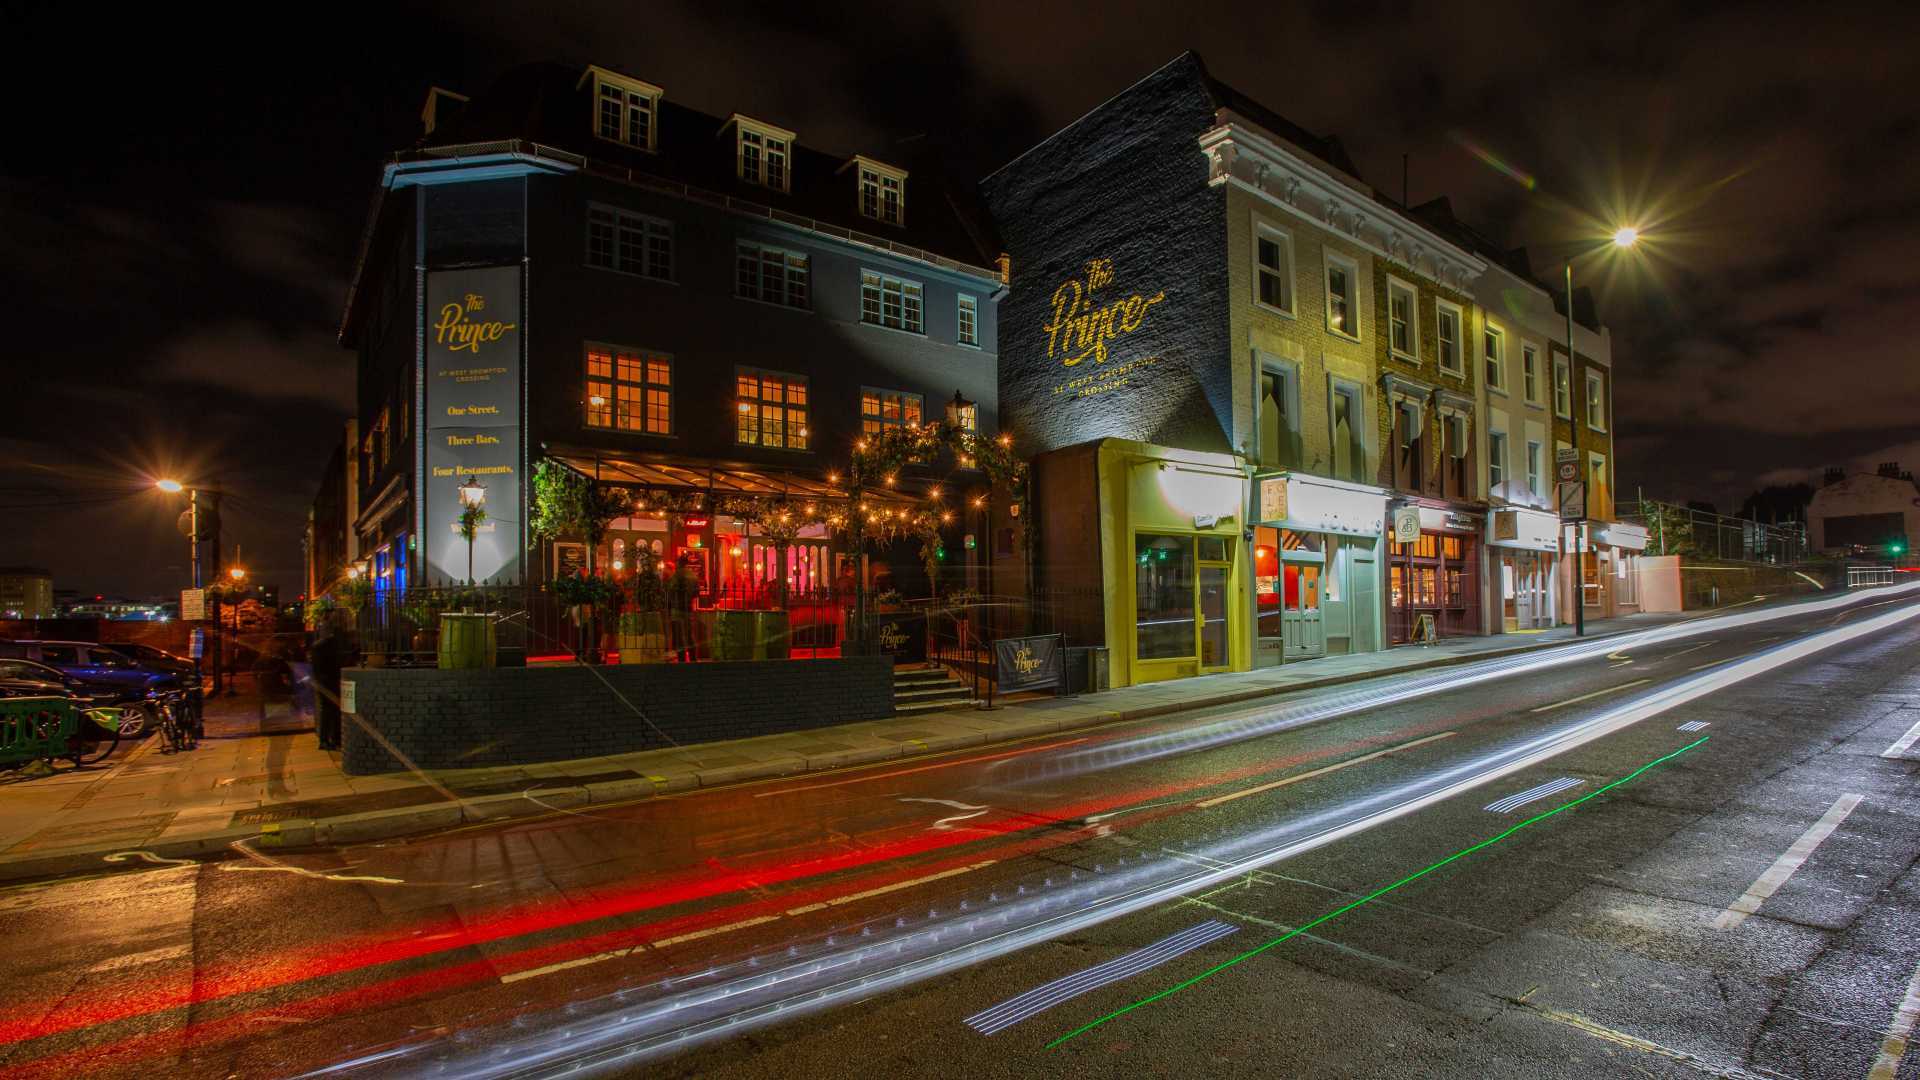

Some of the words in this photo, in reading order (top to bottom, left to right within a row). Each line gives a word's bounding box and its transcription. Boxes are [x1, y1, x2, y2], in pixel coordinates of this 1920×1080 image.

[1083, 258, 1114, 294] The
[465, 293, 485, 313] The
[434, 303, 515, 353] Prince
[1042, 279, 1164, 366] Prince
[447, 406, 466, 416] One
[446, 435, 474, 446] Three
[432, 467, 454, 477] Four
[880, 625, 910, 649] Prince
[1014, 650, 1043, 674] Prince
